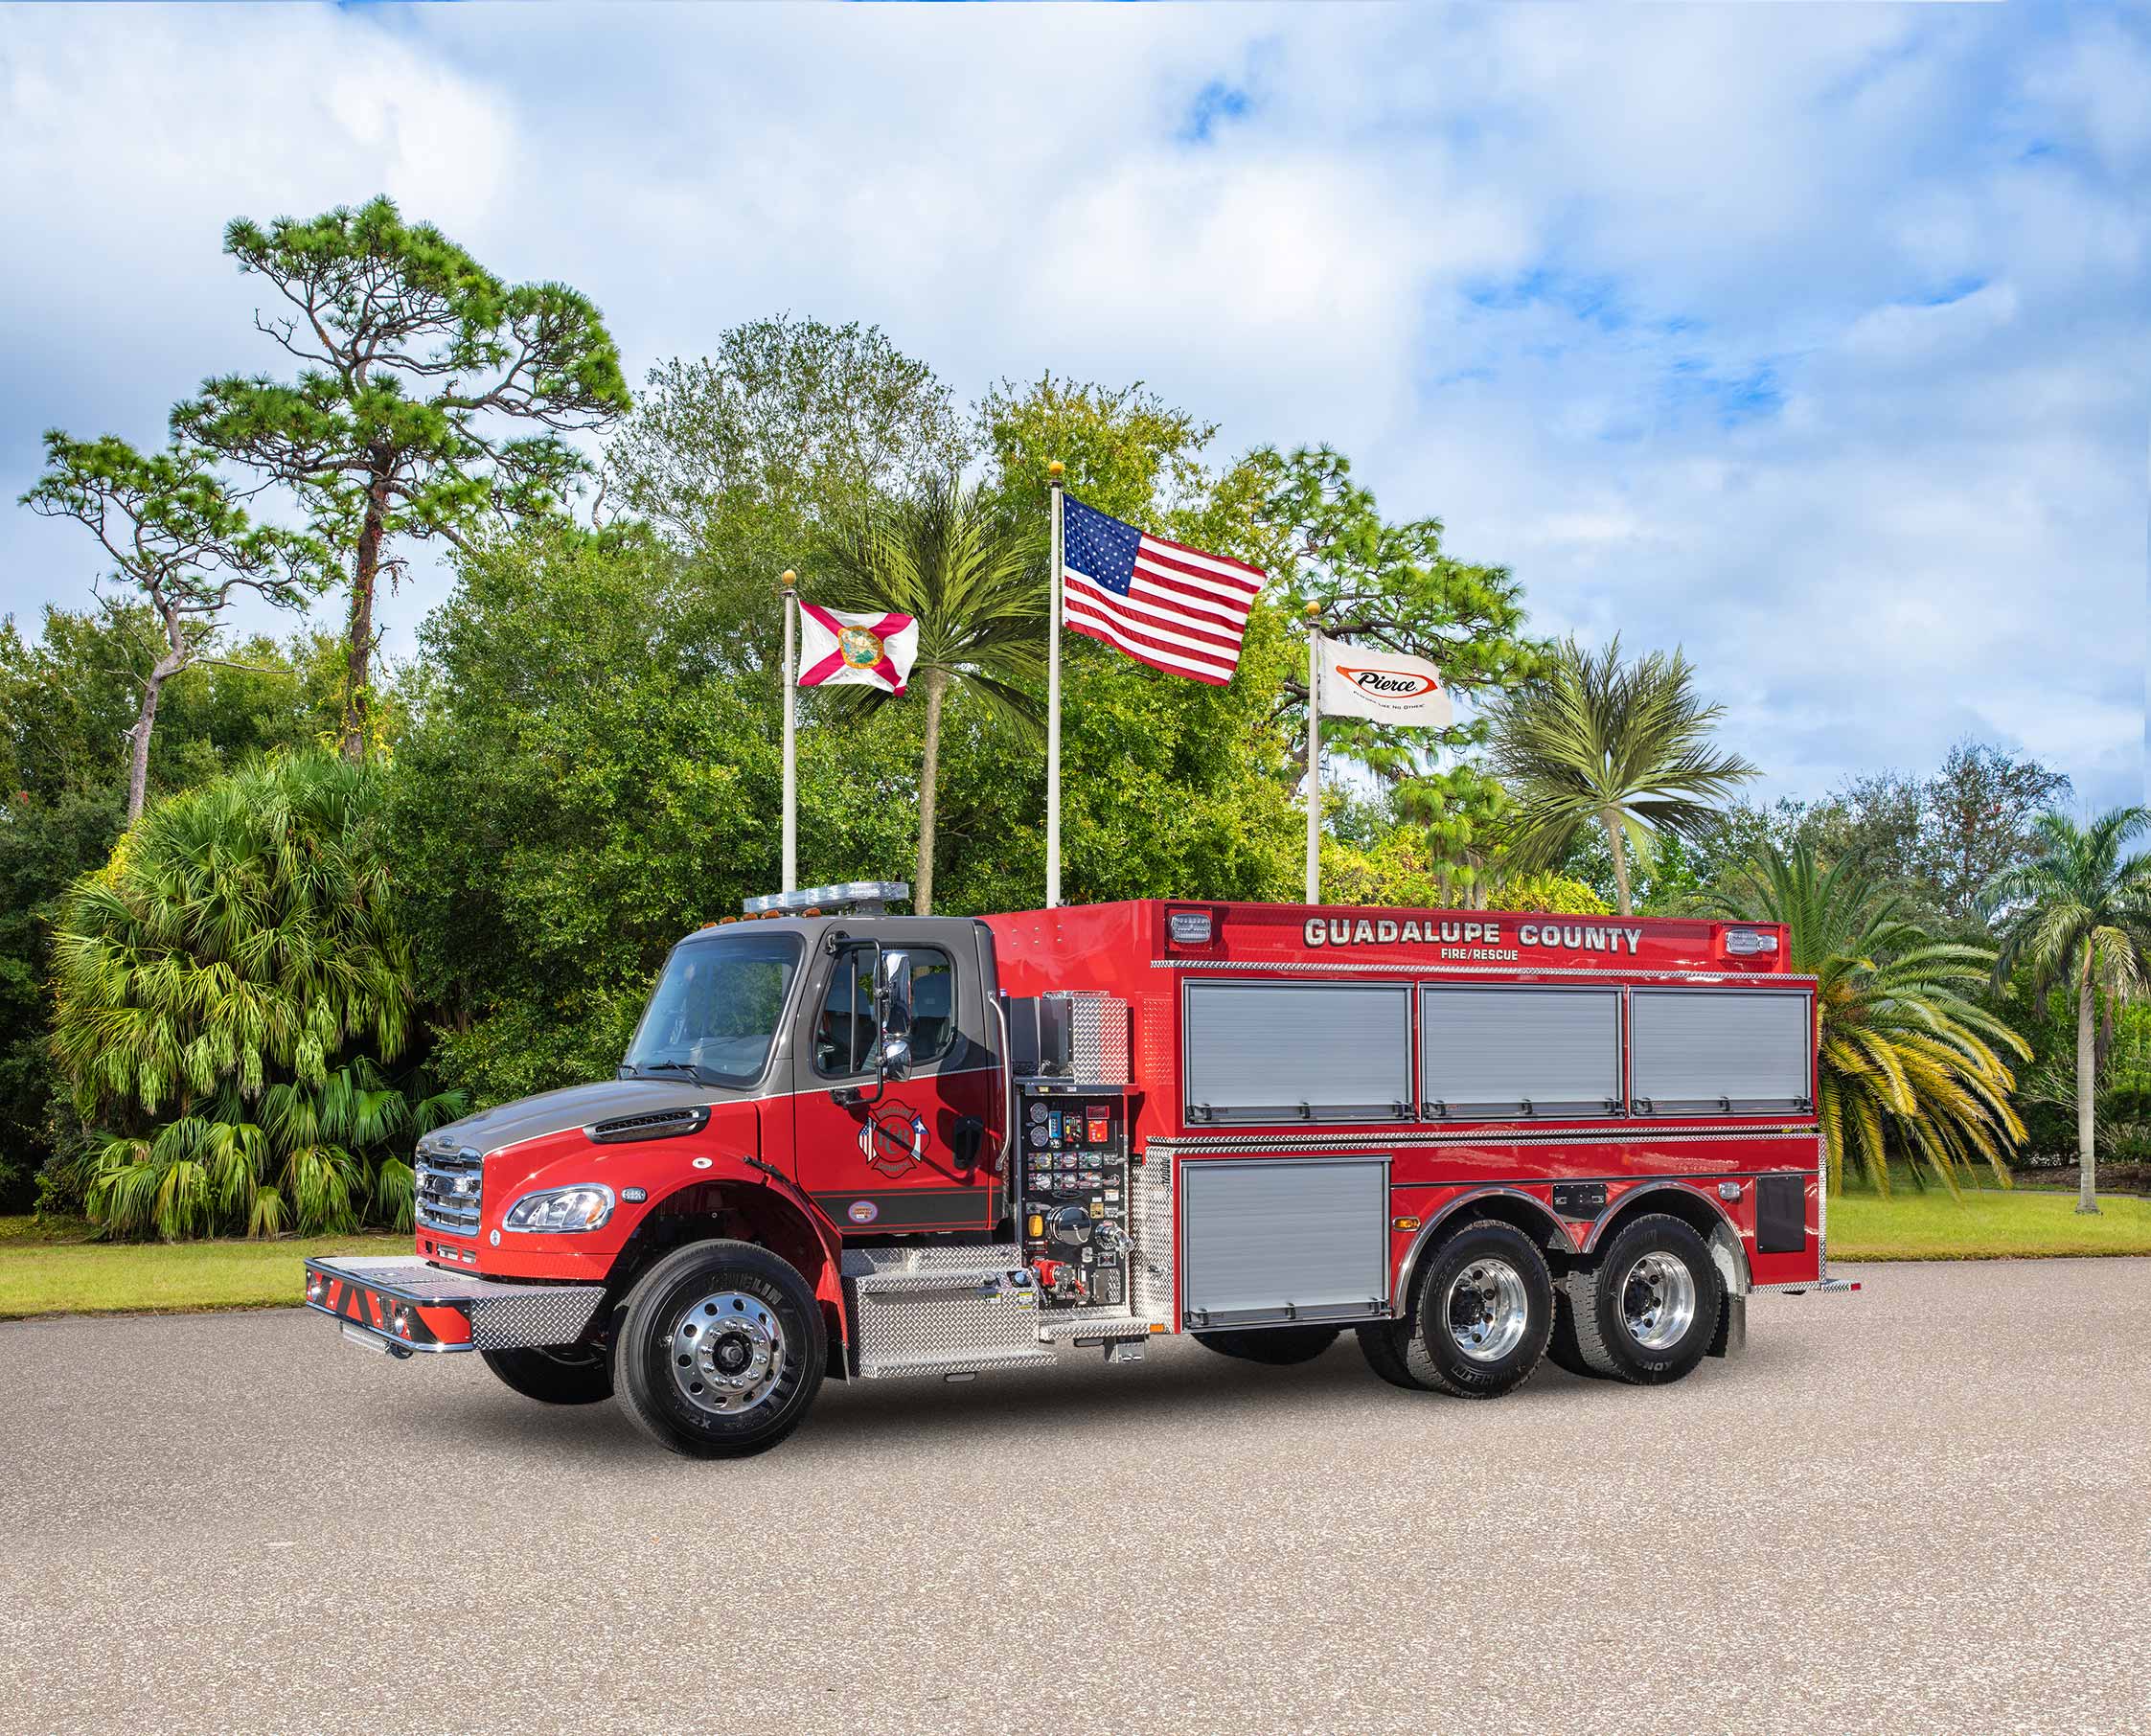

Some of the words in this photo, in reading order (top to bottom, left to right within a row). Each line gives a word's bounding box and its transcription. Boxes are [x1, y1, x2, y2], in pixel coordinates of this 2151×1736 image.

[1358, 672, 1416, 692] Pierce
[1303, 918, 1500, 948] GUADALUPE
[1518, 925, 1642, 955] COUNTY
[1441, 948, 1519, 961] FIRE/RESCUE
